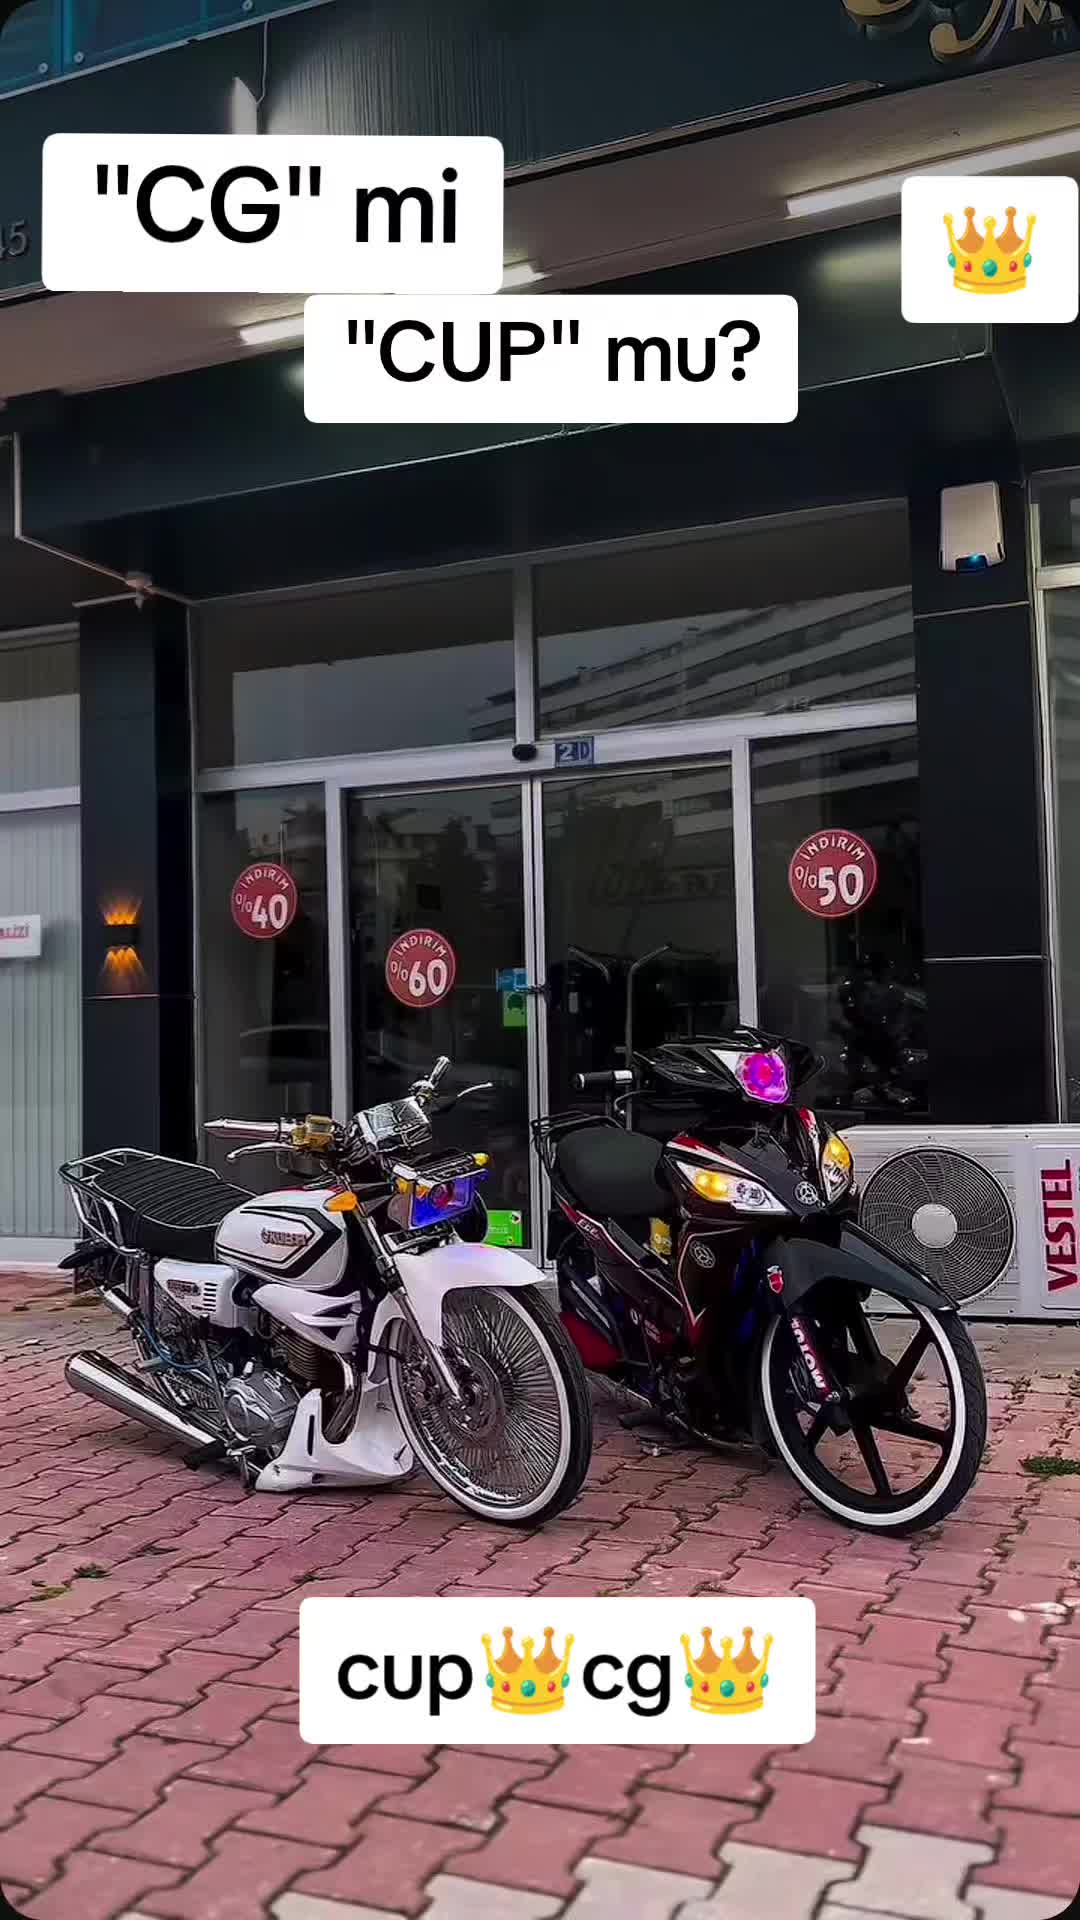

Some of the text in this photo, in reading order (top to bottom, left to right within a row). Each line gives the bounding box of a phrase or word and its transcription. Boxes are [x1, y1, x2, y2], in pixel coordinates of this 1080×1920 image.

[795, 865, 864, 906] %50
[235, 893, 288, 929] %40
[391, 959, 447, 997] %60
[1041, 1159, 1078, 1292] VESTEL
